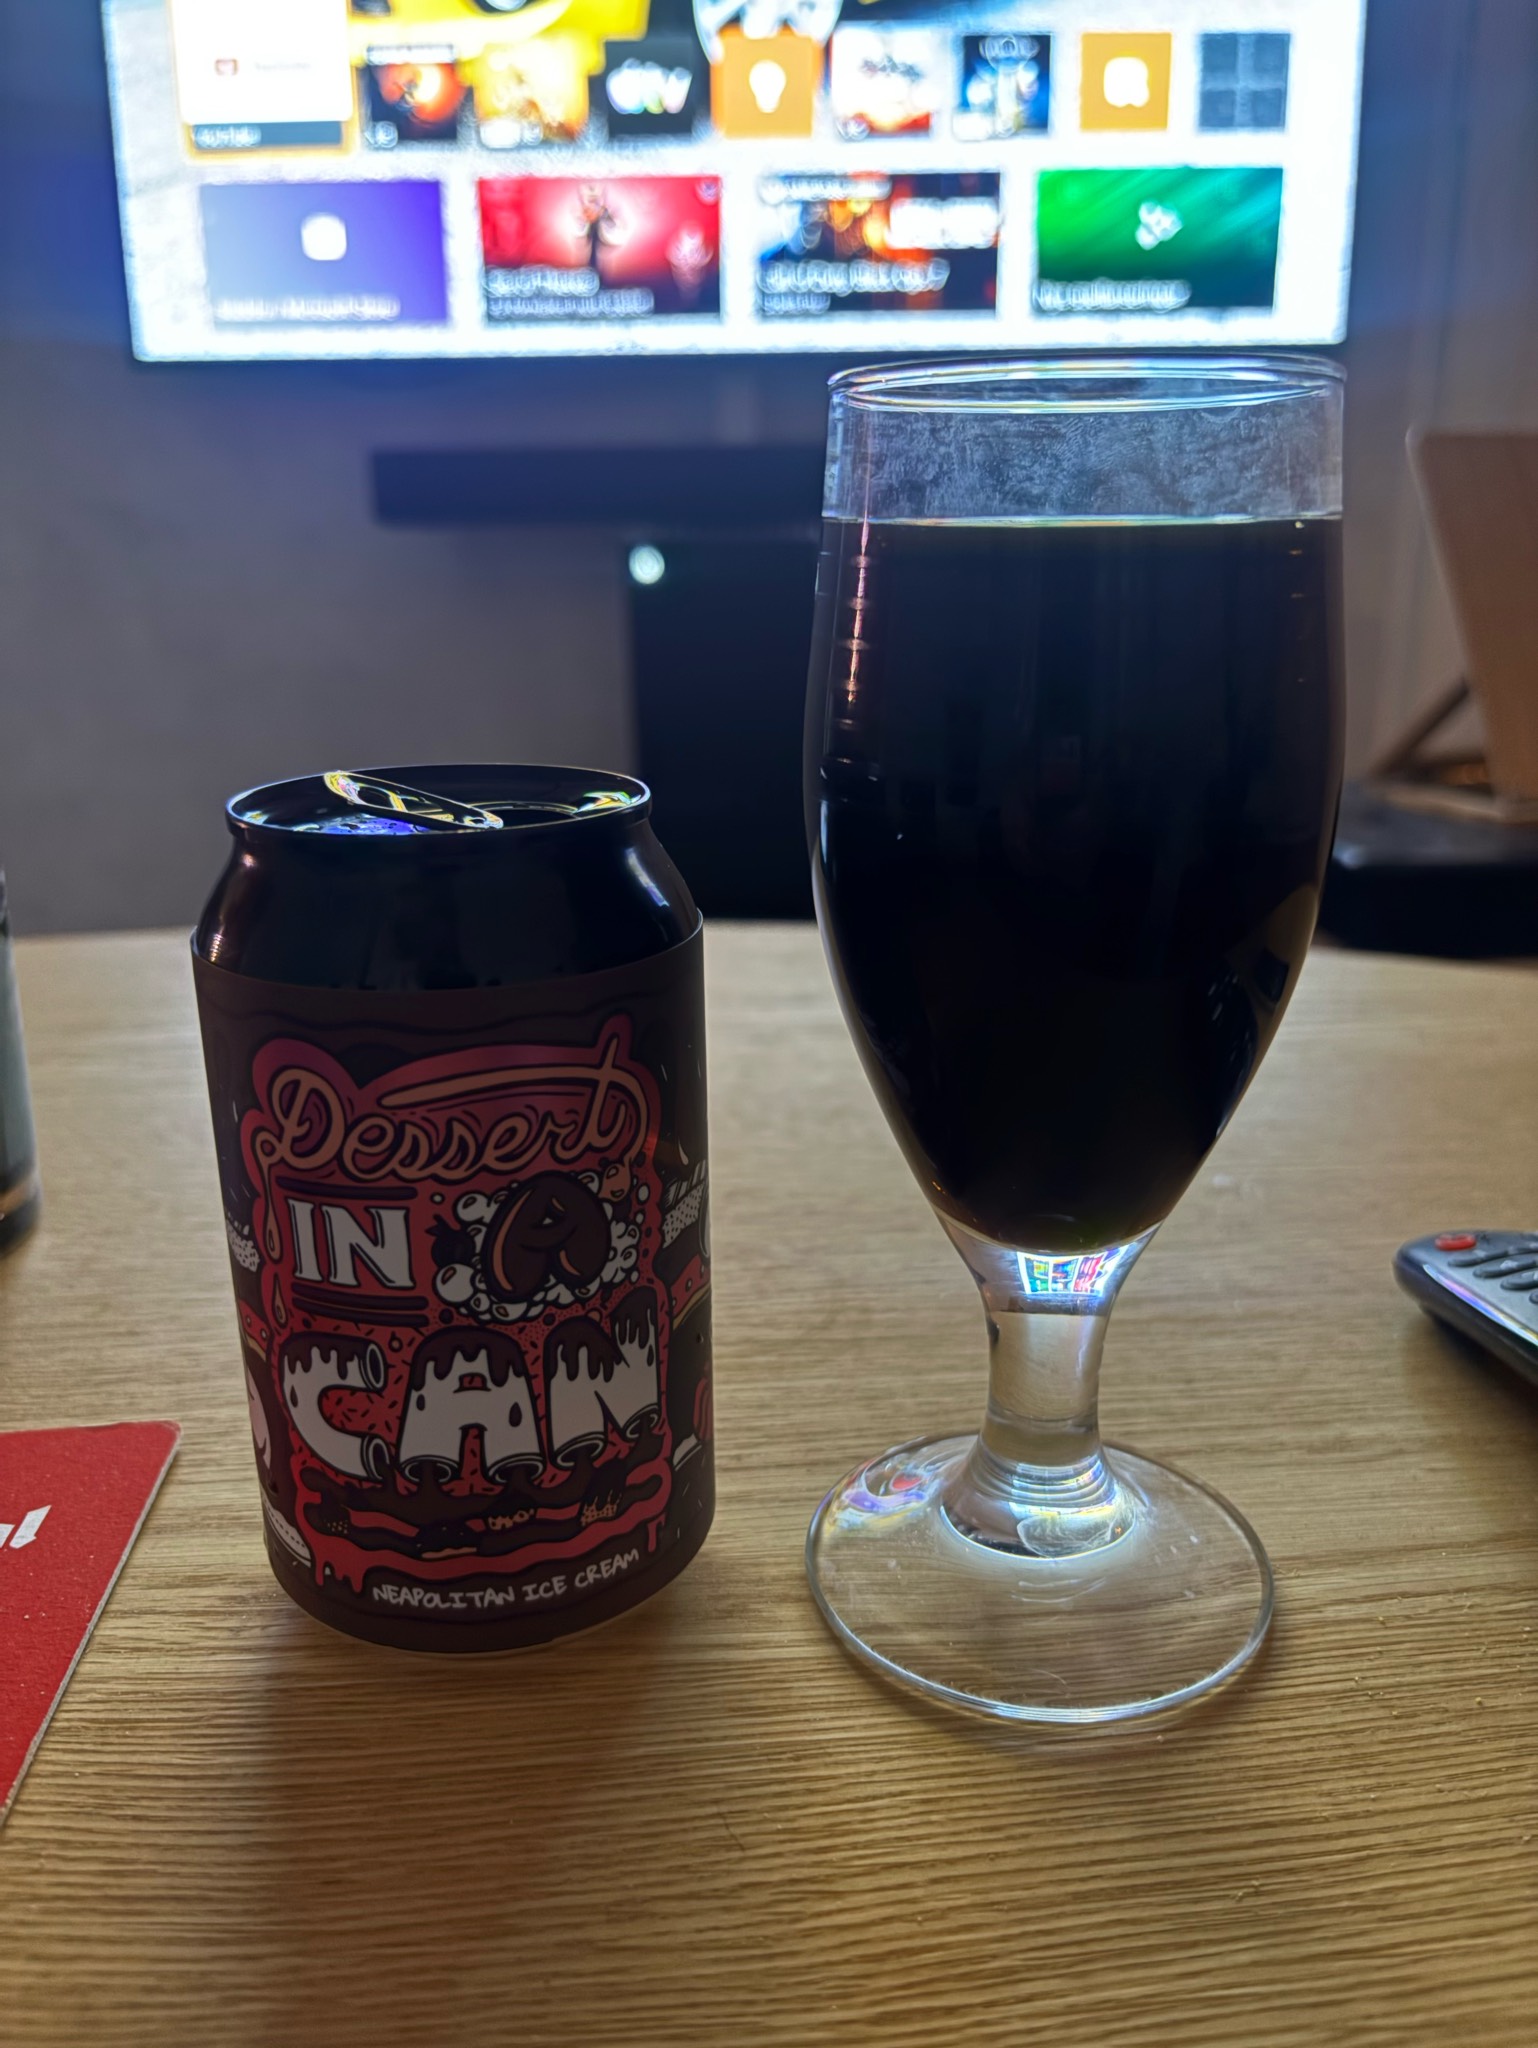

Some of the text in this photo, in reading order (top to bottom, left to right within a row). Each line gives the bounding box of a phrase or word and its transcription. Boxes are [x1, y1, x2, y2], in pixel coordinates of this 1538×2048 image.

[255, 1036, 650, 1183] Dessert
[285, 1198, 416, 1289] IN
[280, 1286, 663, 1484] CAN
[372, 1548, 640, 1610] NEAPOLITAN ICE CREAM
